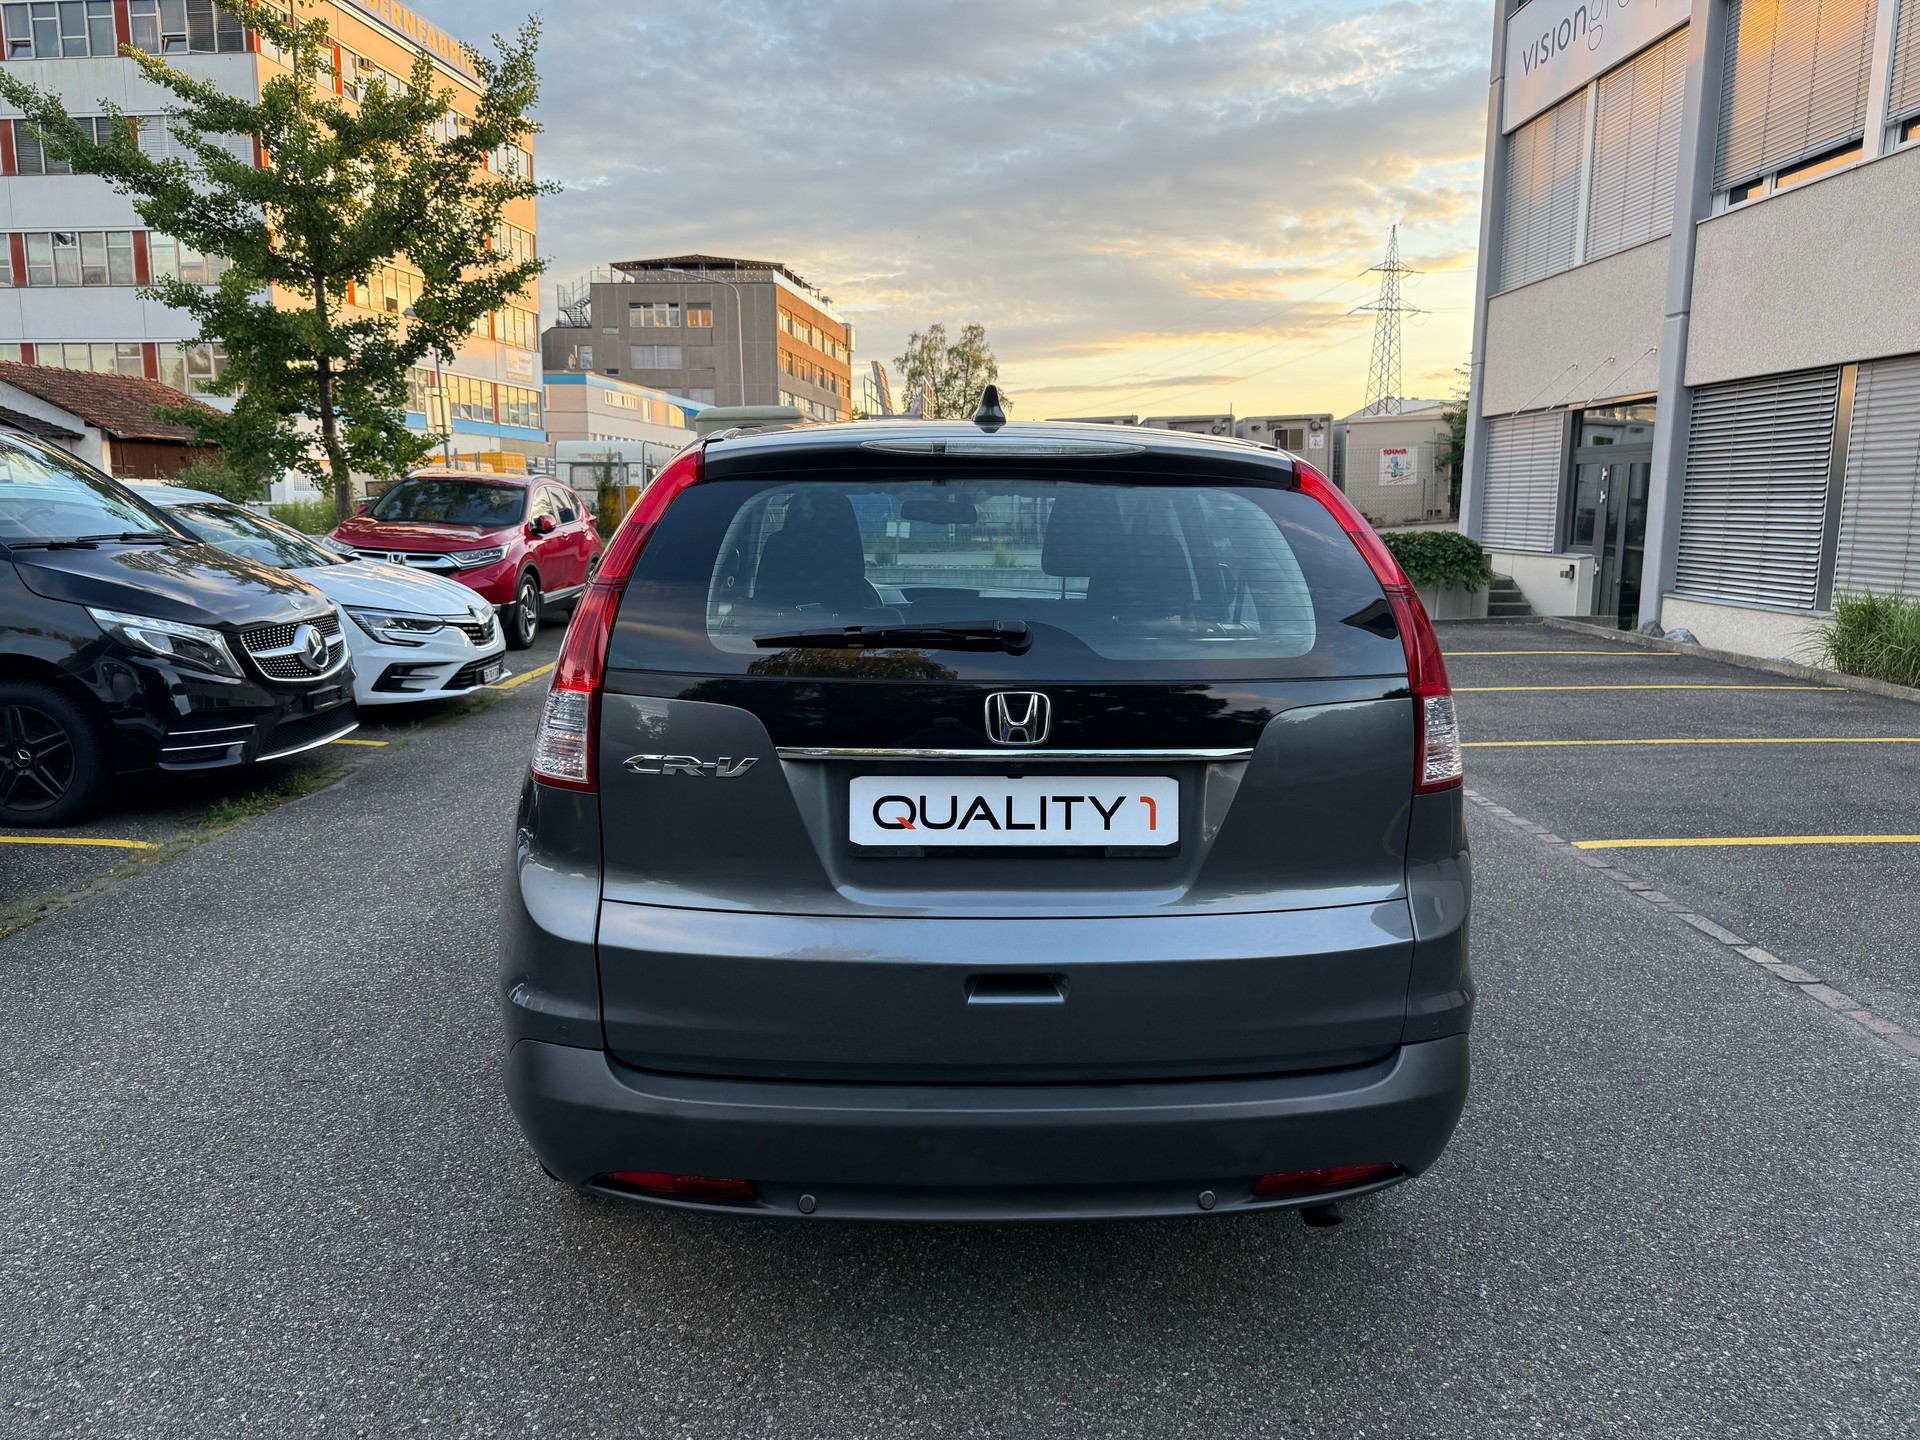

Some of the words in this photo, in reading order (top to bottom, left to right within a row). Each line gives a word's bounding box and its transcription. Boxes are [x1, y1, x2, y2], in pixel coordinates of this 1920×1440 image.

[623, 754, 760, 777] CR-V
[872, 795, 1127, 830] QUALITY
[1140, 796, 1157, 830] 1
